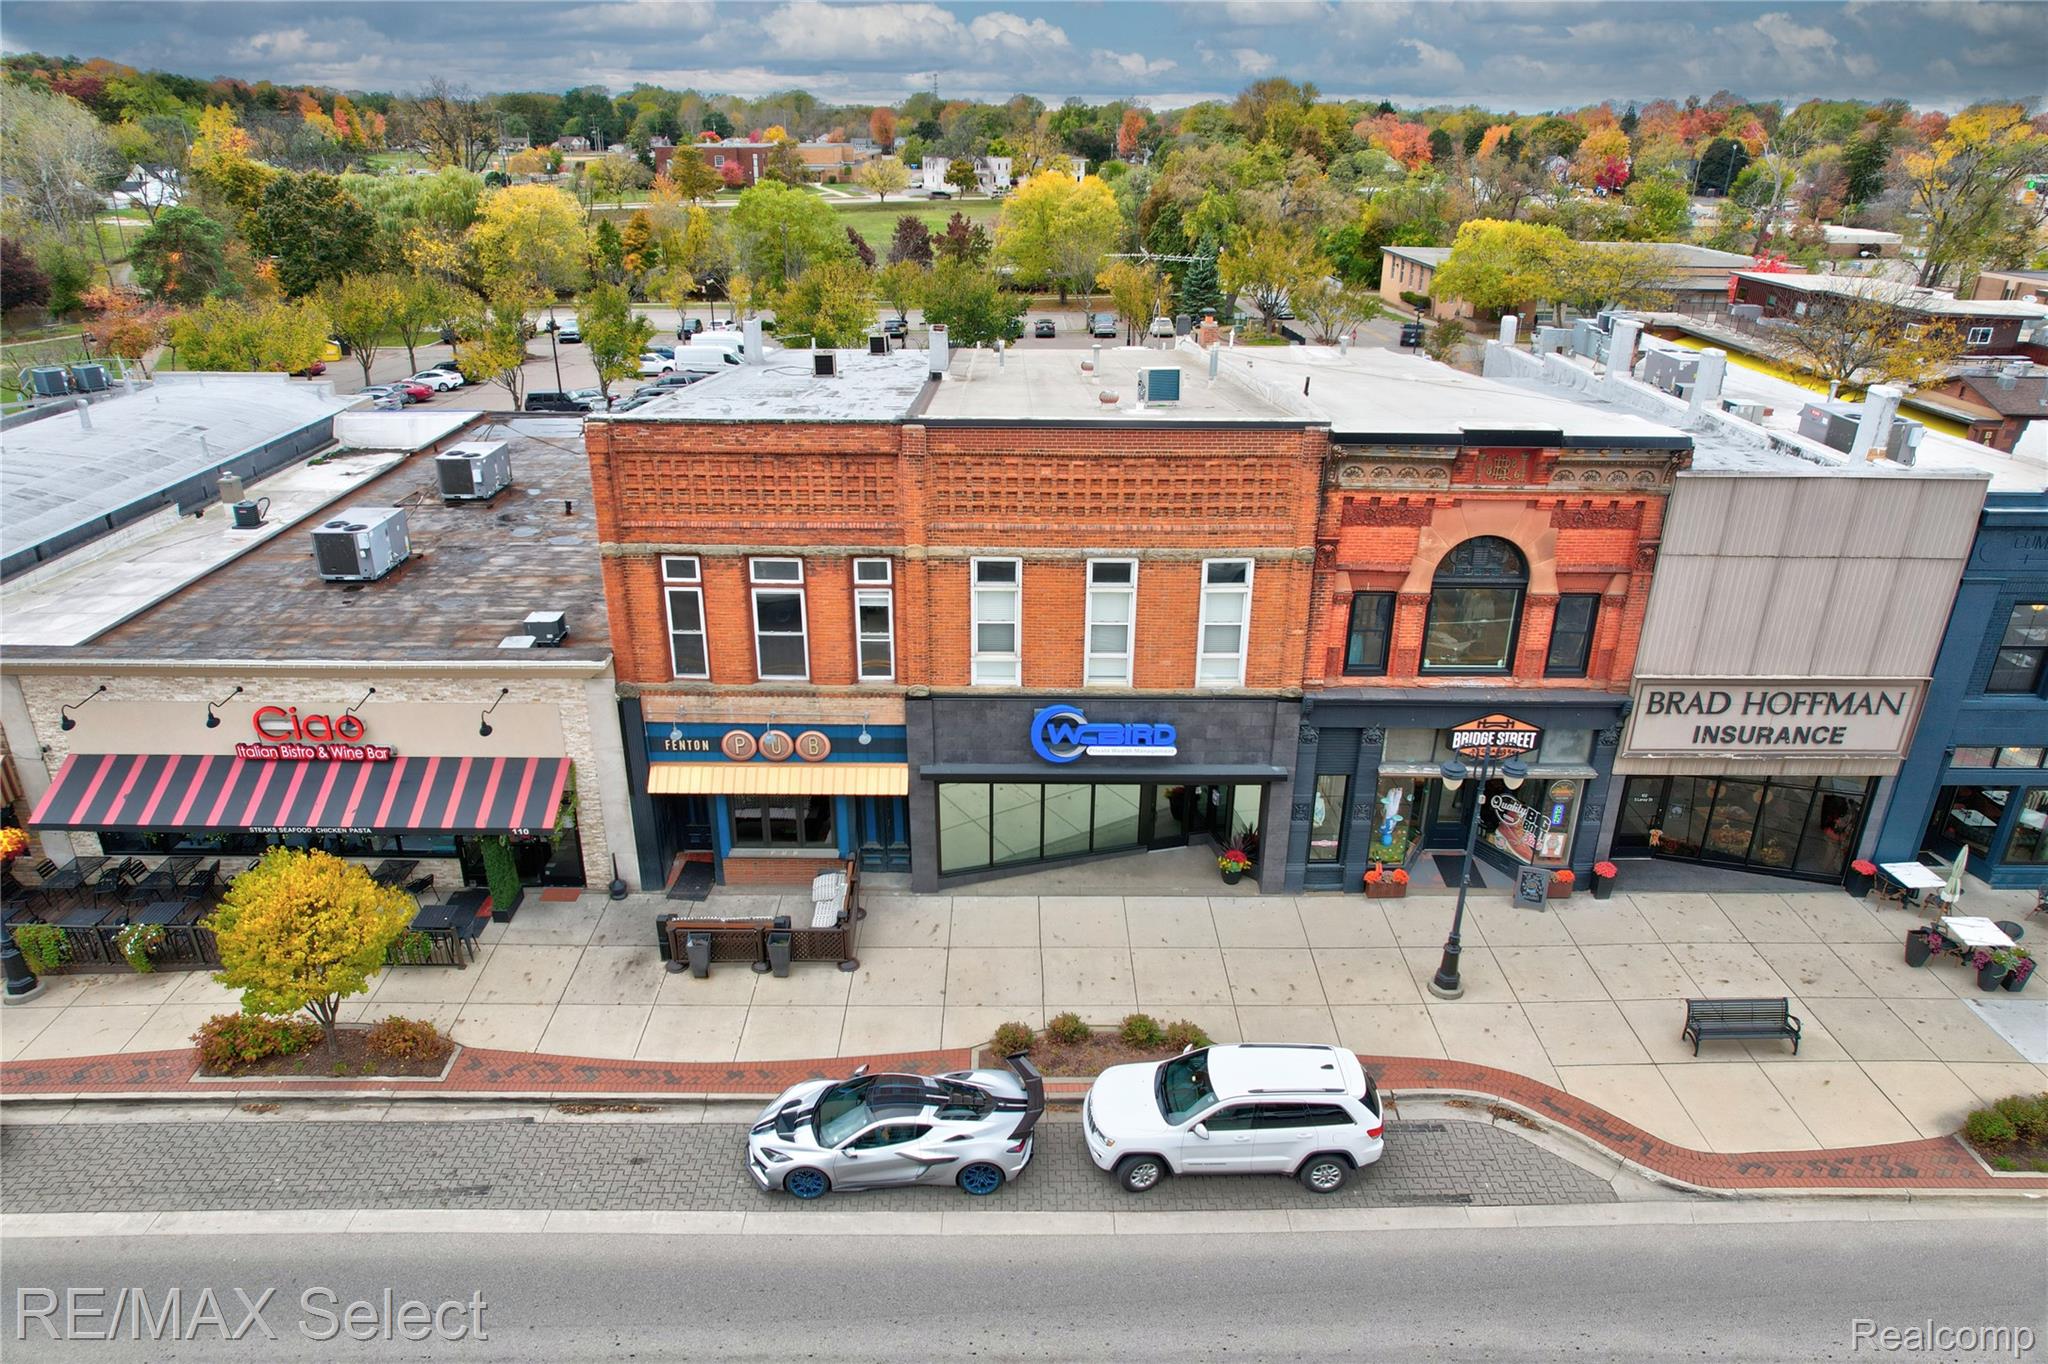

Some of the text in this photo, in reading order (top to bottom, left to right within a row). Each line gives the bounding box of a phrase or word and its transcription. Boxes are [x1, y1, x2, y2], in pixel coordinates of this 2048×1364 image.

[1646, 691, 1906, 716] BRAD HOFFMAN
[254, 706, 364, 741] Ciao
[665, 739, 710, 751] FENTON
[1452, 731, 1537, 749] BRIDGE STREET
[1692, 725, 1847, 745] INSURANCE
[237, 745, 389, 760] Italian Bistro & Wine Bar
[1491, 795, 1528, 817] Quality
